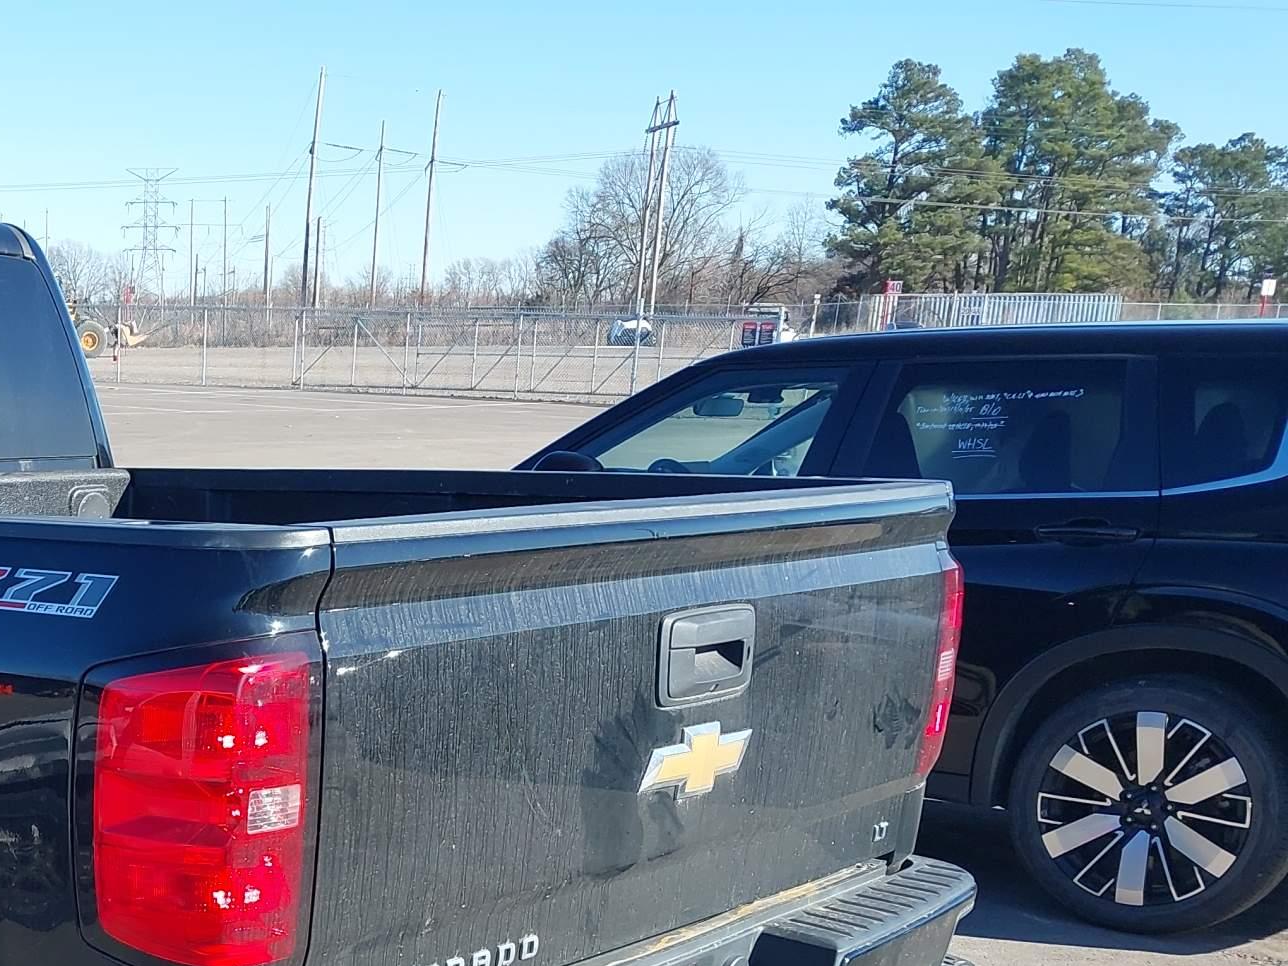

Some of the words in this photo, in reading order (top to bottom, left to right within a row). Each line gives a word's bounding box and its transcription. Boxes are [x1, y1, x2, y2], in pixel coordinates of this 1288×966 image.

[27, 602, 54, 612] OFF
[55, 605, 96, 617] ROAD
[872, 821, 889, 842] LT
